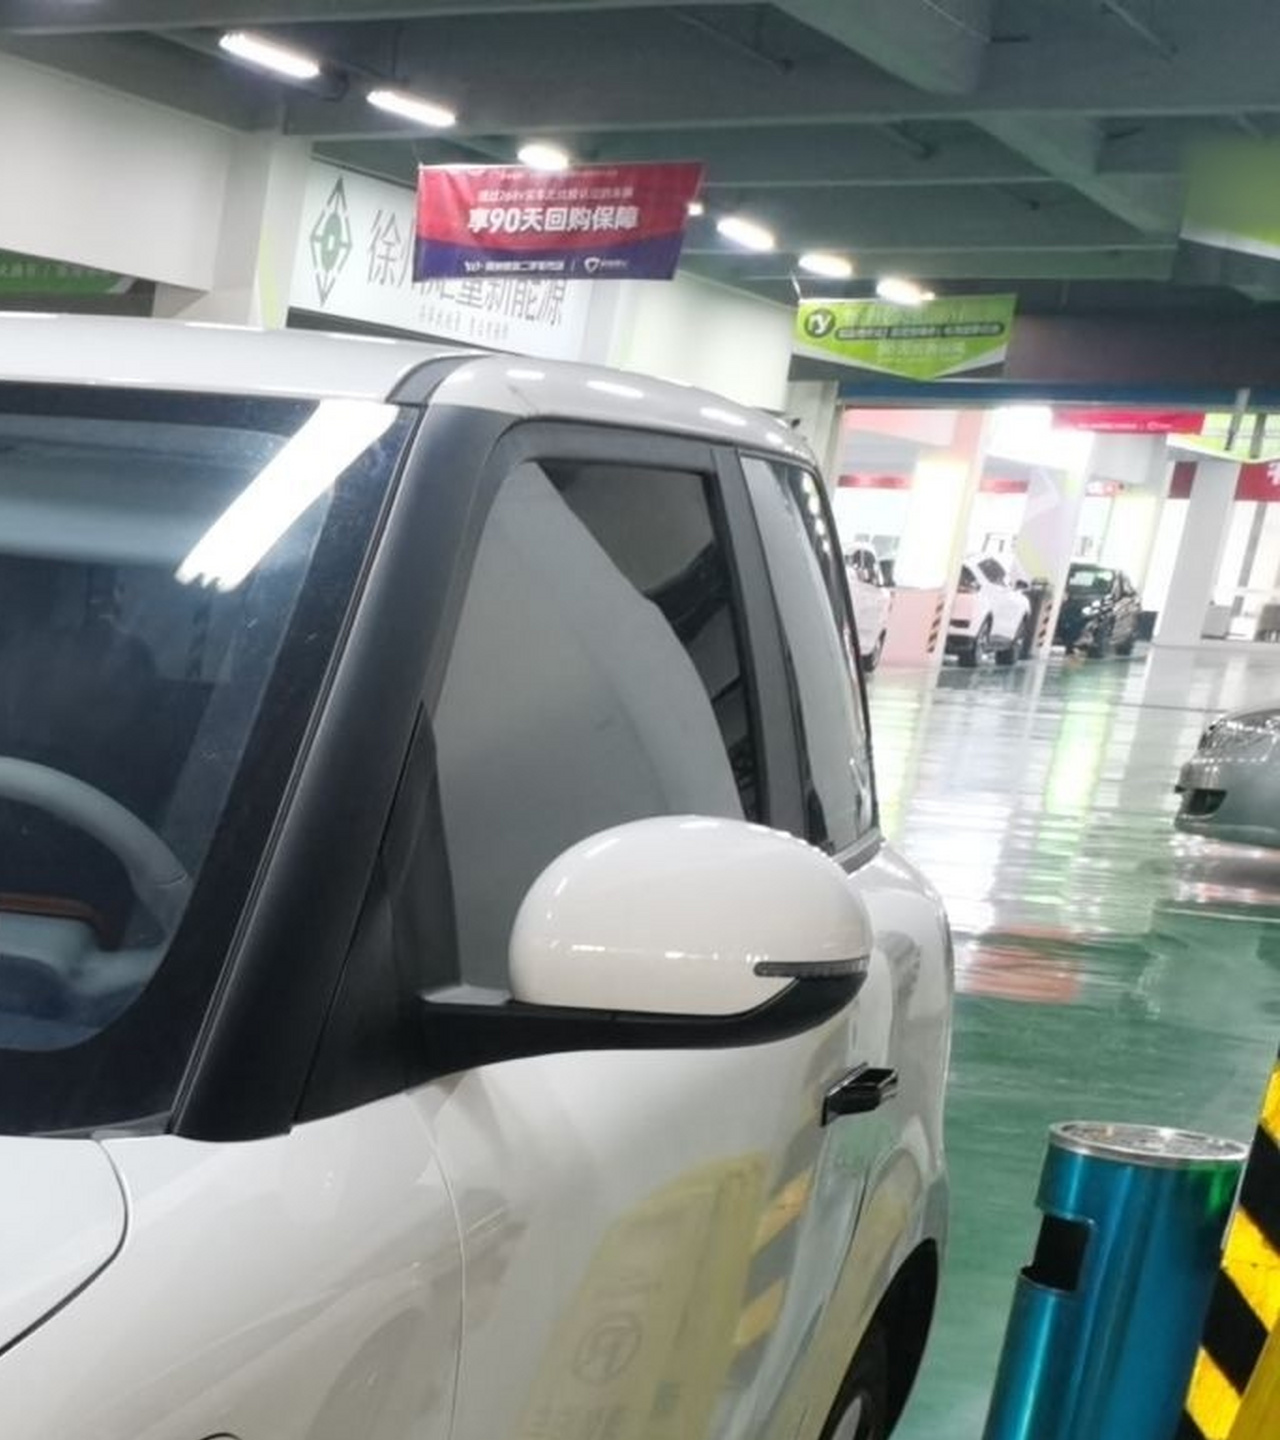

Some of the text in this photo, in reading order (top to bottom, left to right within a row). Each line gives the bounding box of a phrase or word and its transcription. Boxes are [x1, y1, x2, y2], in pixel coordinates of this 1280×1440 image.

[468, 206, 640, 233] 享90天回购保障
